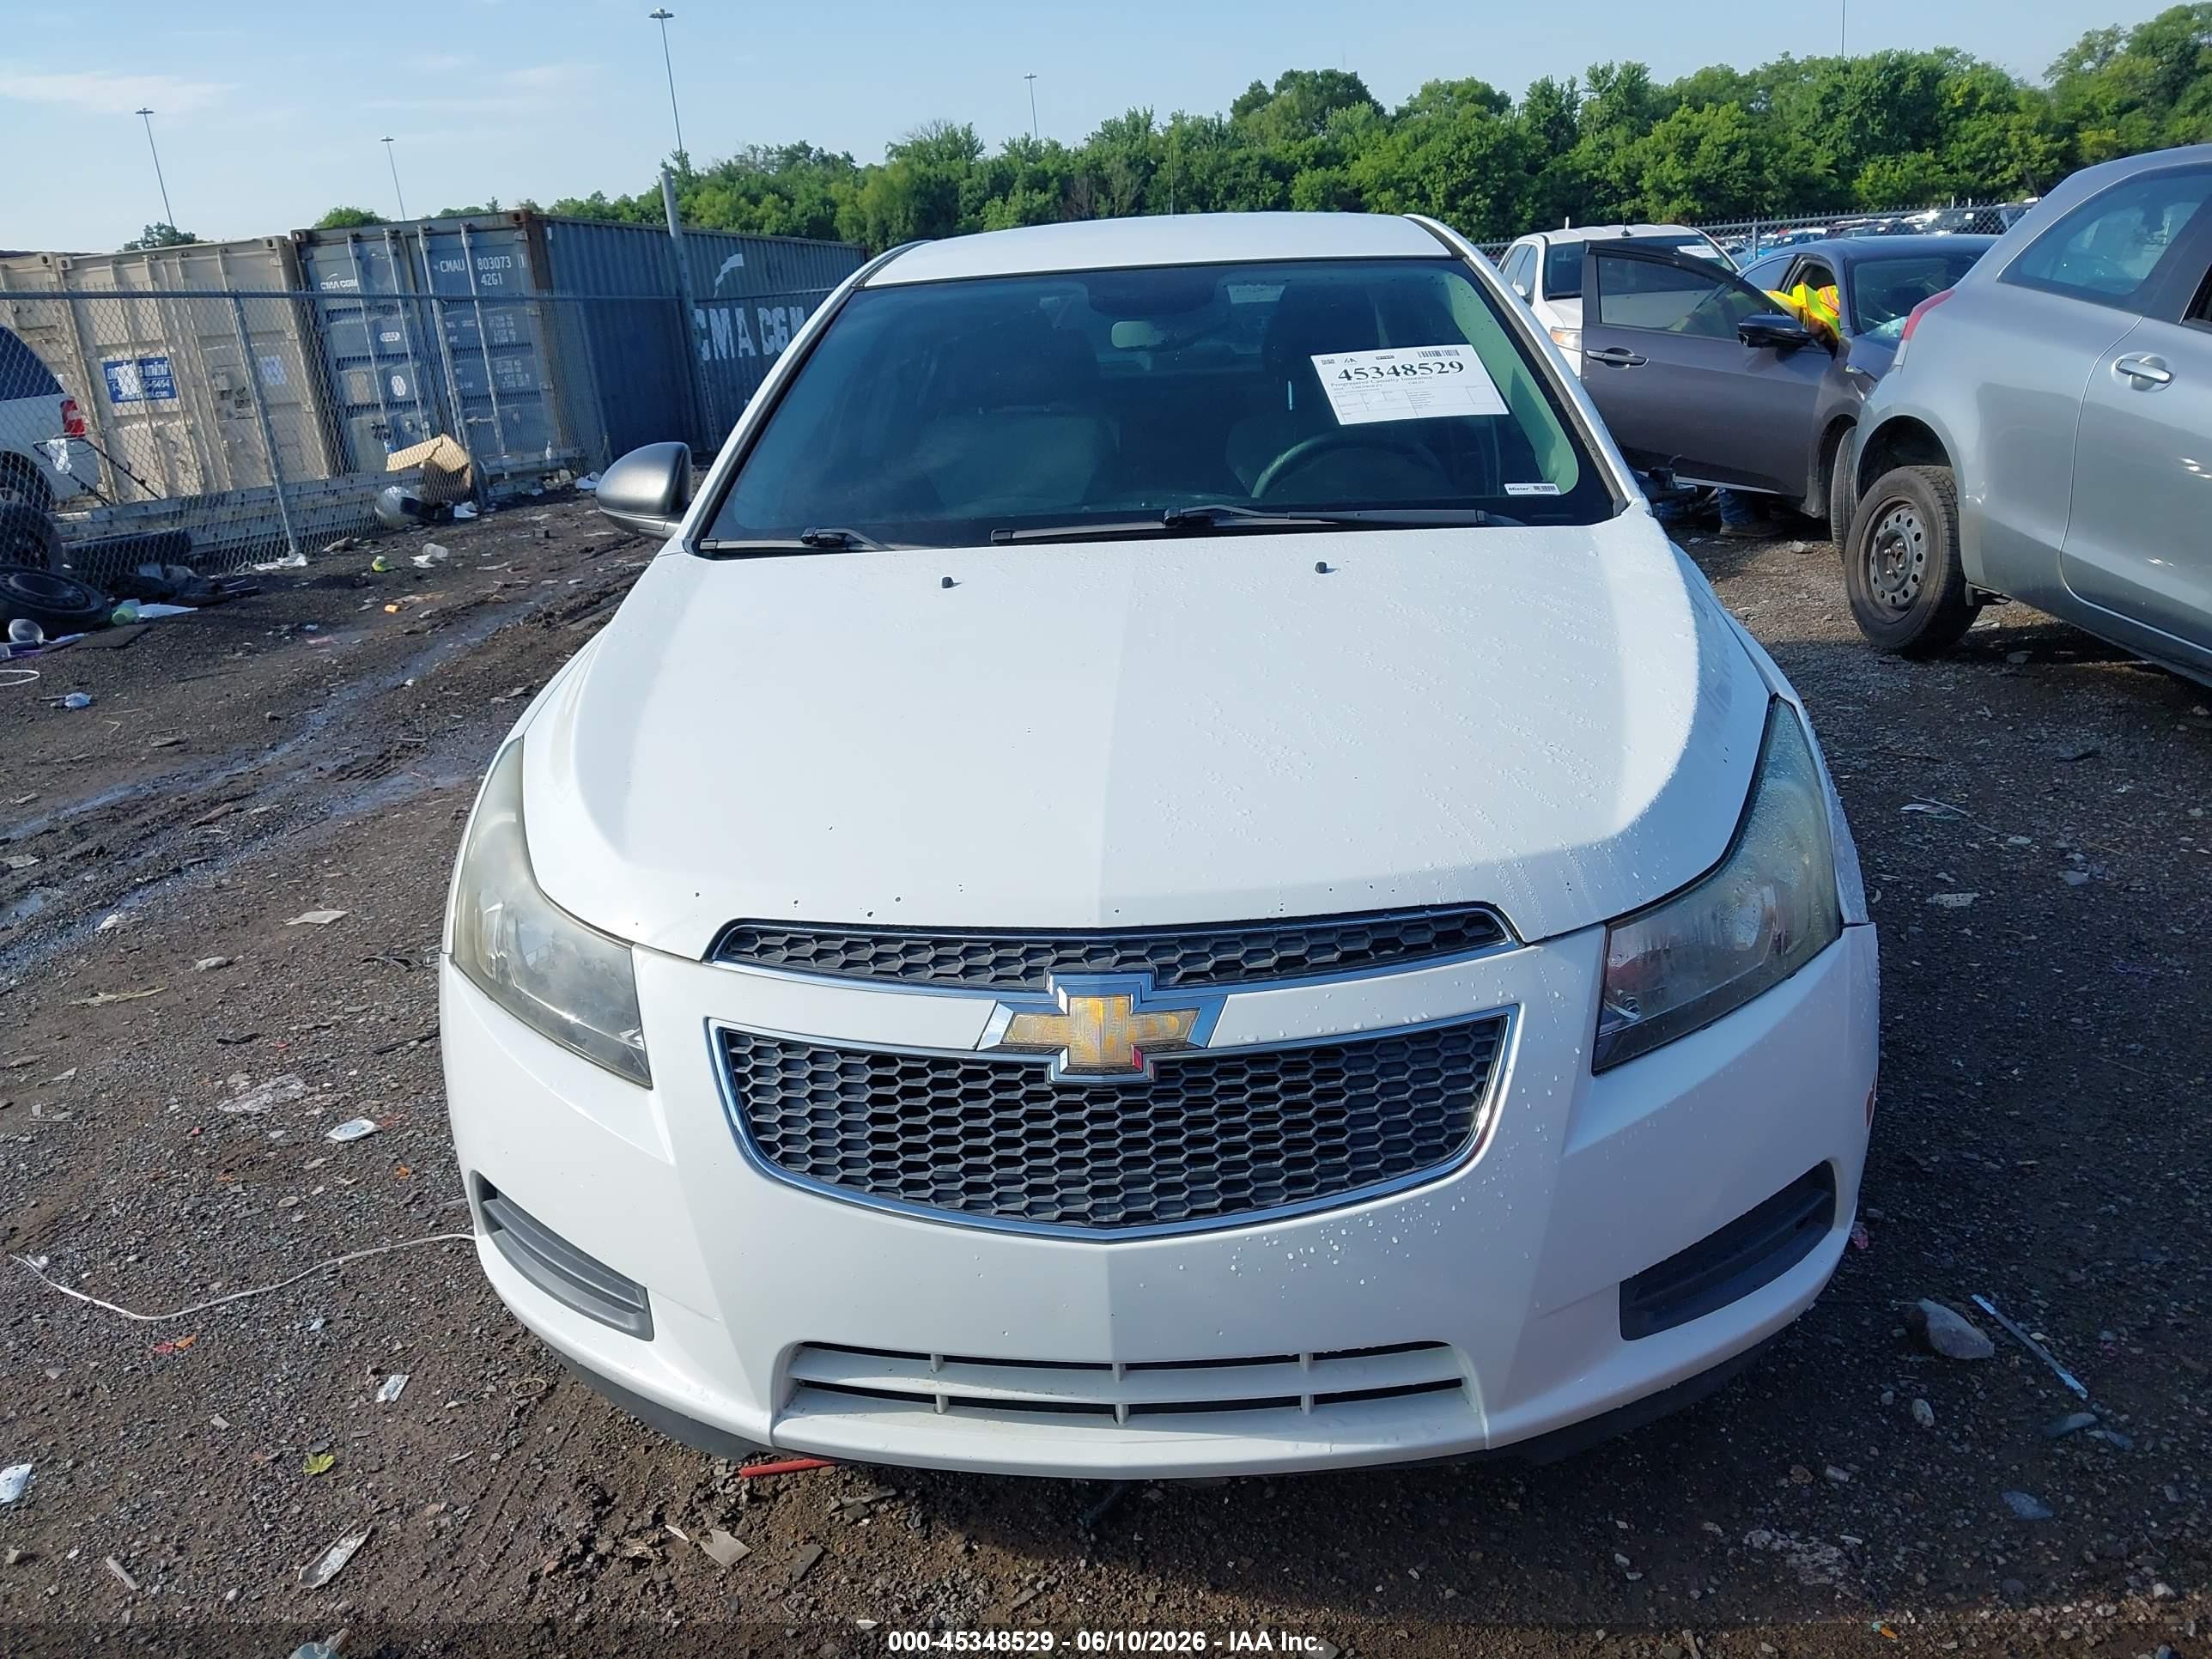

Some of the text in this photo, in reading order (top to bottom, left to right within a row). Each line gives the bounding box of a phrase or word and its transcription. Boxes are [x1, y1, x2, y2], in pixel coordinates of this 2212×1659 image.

[440, 259, 465, 273] CMAU
[477, 256, 512, 270] 803073
[320, 281, 340, 290] CMA
[481, 272, 502, 286] 42G1
[1338, 361, 1464, 381] 45348529
